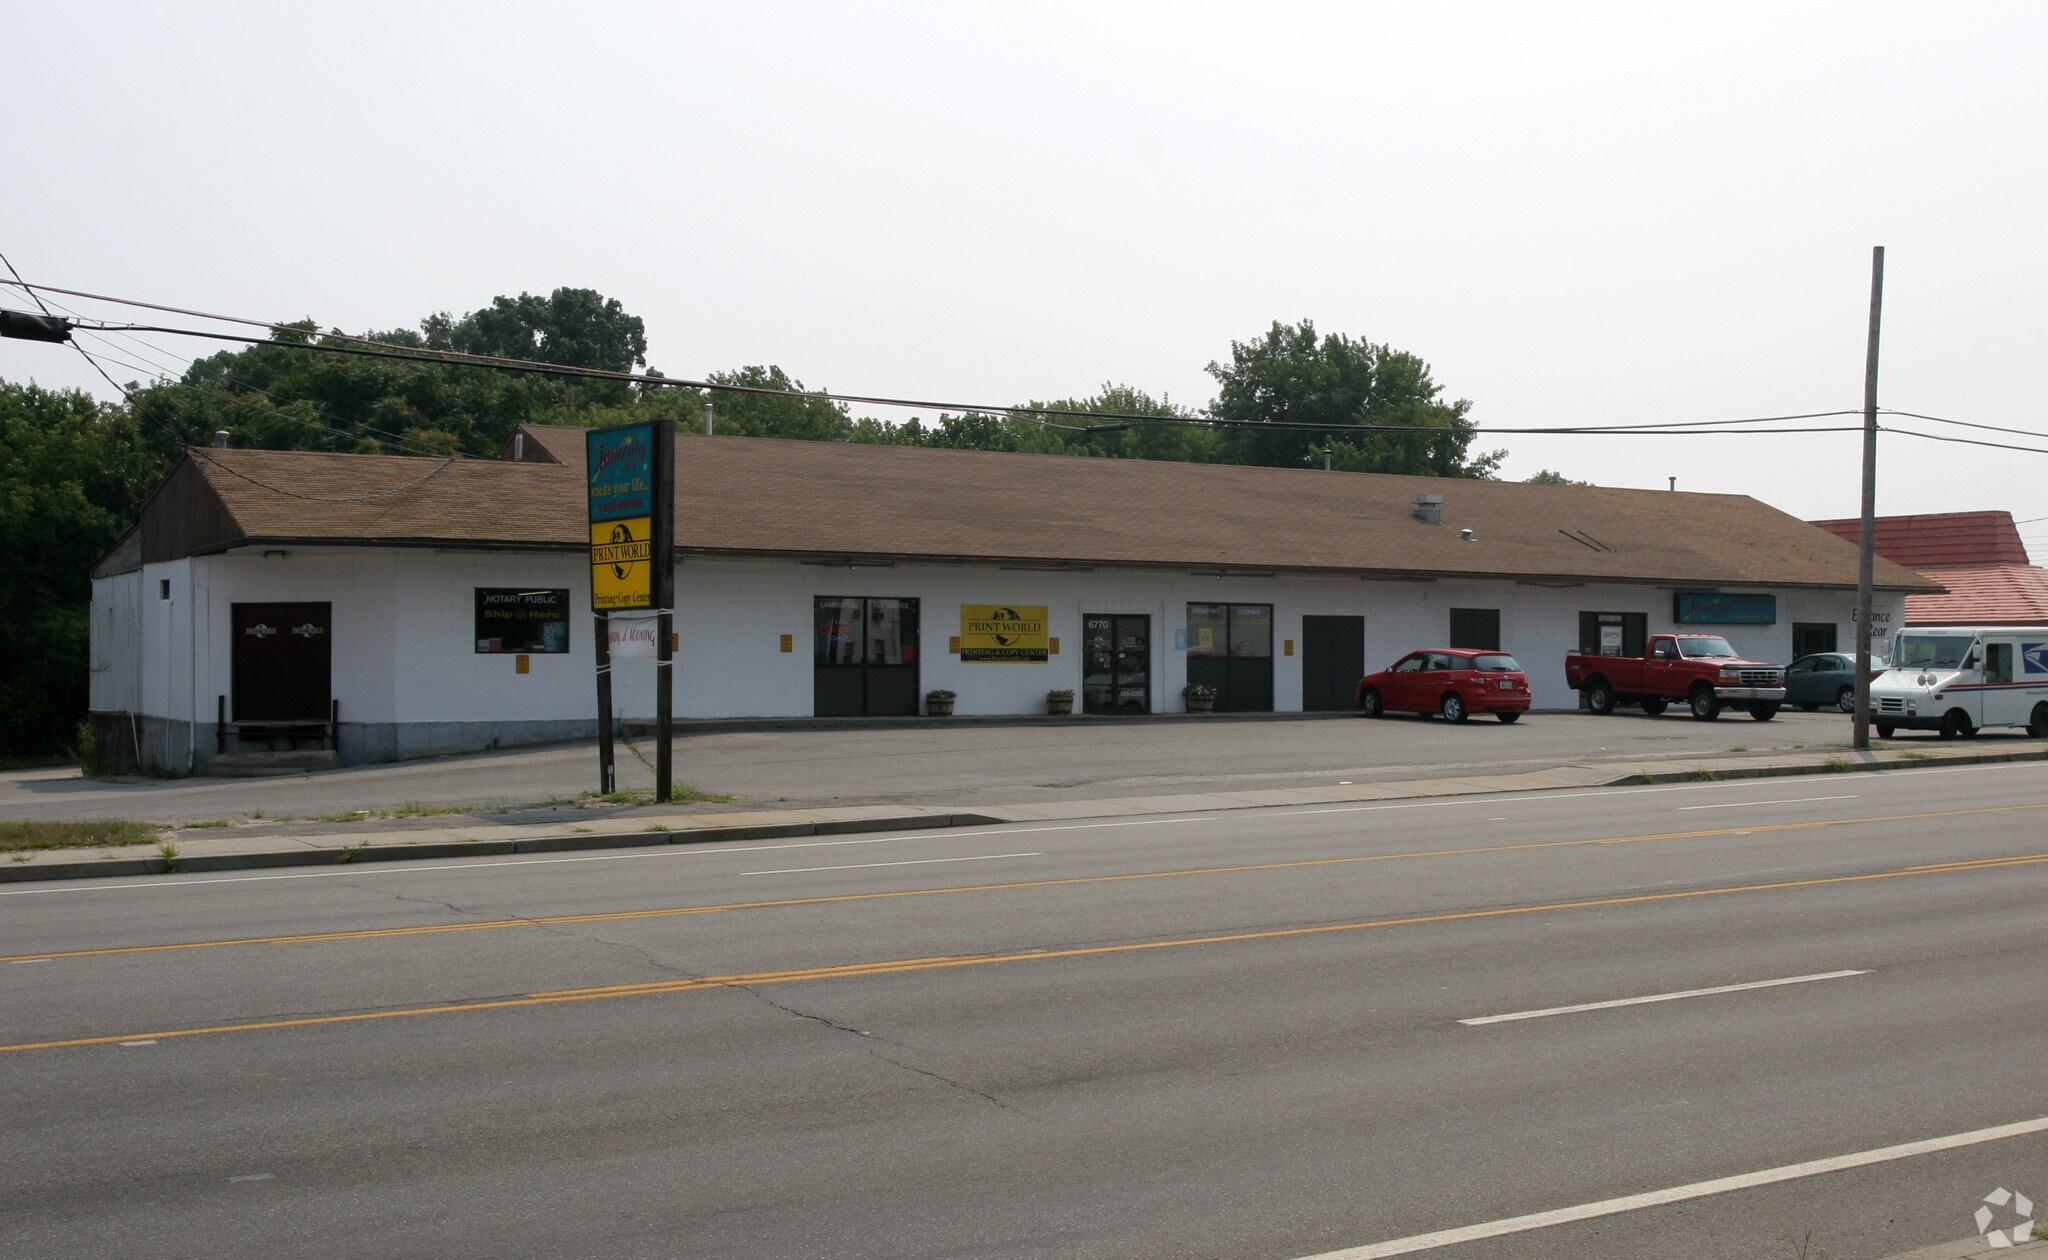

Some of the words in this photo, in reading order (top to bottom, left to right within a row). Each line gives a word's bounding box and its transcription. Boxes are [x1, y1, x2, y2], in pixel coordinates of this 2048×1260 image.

[613, 482, 630, 498] your
[593, 546, 620, 562] PRINT
[620, 543, 651, 560] WORLD
[486, 595, 521, 604] NOTARY
[525, 595, 557, 604] PUBLIC
[484, 609, 513, 620] Ship
[528, 610, 560, 619] Here
[1852, 608, 1890, 622] Eance
[968, 622, 999, 632] PRINT
[1002, 622, 1041, 632] WORLD
[1088, 620, 1109, 629] 6770
